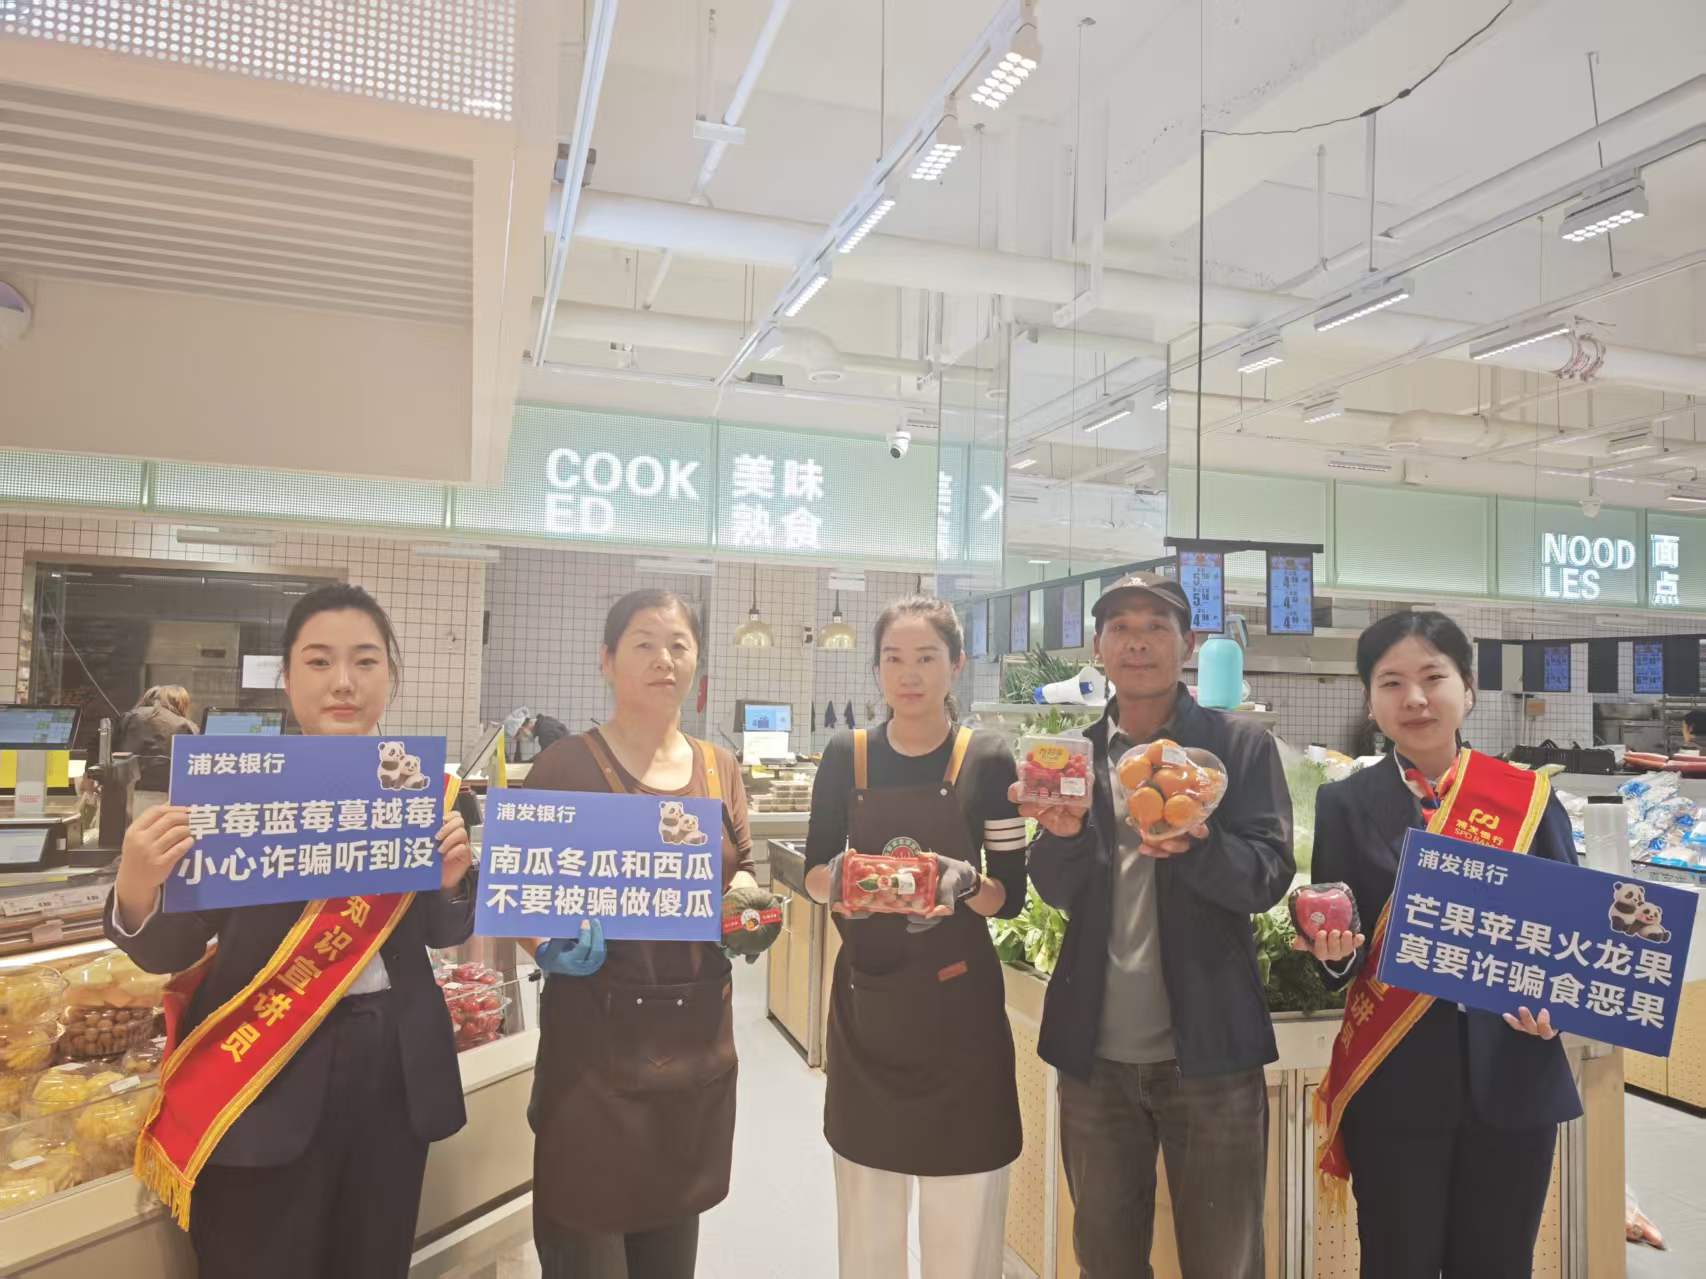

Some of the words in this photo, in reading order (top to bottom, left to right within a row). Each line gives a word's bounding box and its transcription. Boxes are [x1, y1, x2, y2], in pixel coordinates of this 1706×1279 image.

[545, 447, 701, 500] COOK
[732, 453, 825, 502] 美味
[545, 494, 616, 535] ED
[731, 503, 823, 551] 熟食
[1542, 532, 1636, 570] NOOD
[1651, 534, 1681, 605] 面点
[1542, 566, 1601, 600] LES
[187, 751, 286, 776] 浦发银行
[187, 796, 437, 841] 草莓蓝莓蔓越莓
[496, 801, 576, 825] 浦发银行
[178, 837, 434, 885] 小心诈骗听到没
[489, 845, 714, 881] 南瓜冬瓜和西瓜
[1417, 847, 1509, 886] 浦发银行
[486, 883, 714, 919] 不要被骗做傻瓜
[1405, 892, 1673, 987] 芒果苹果火龙果
[220, 894, 371, 1063] 知识宣讲员
[1395, 932, 1665, 1030] 莫要诈骗食恶果
